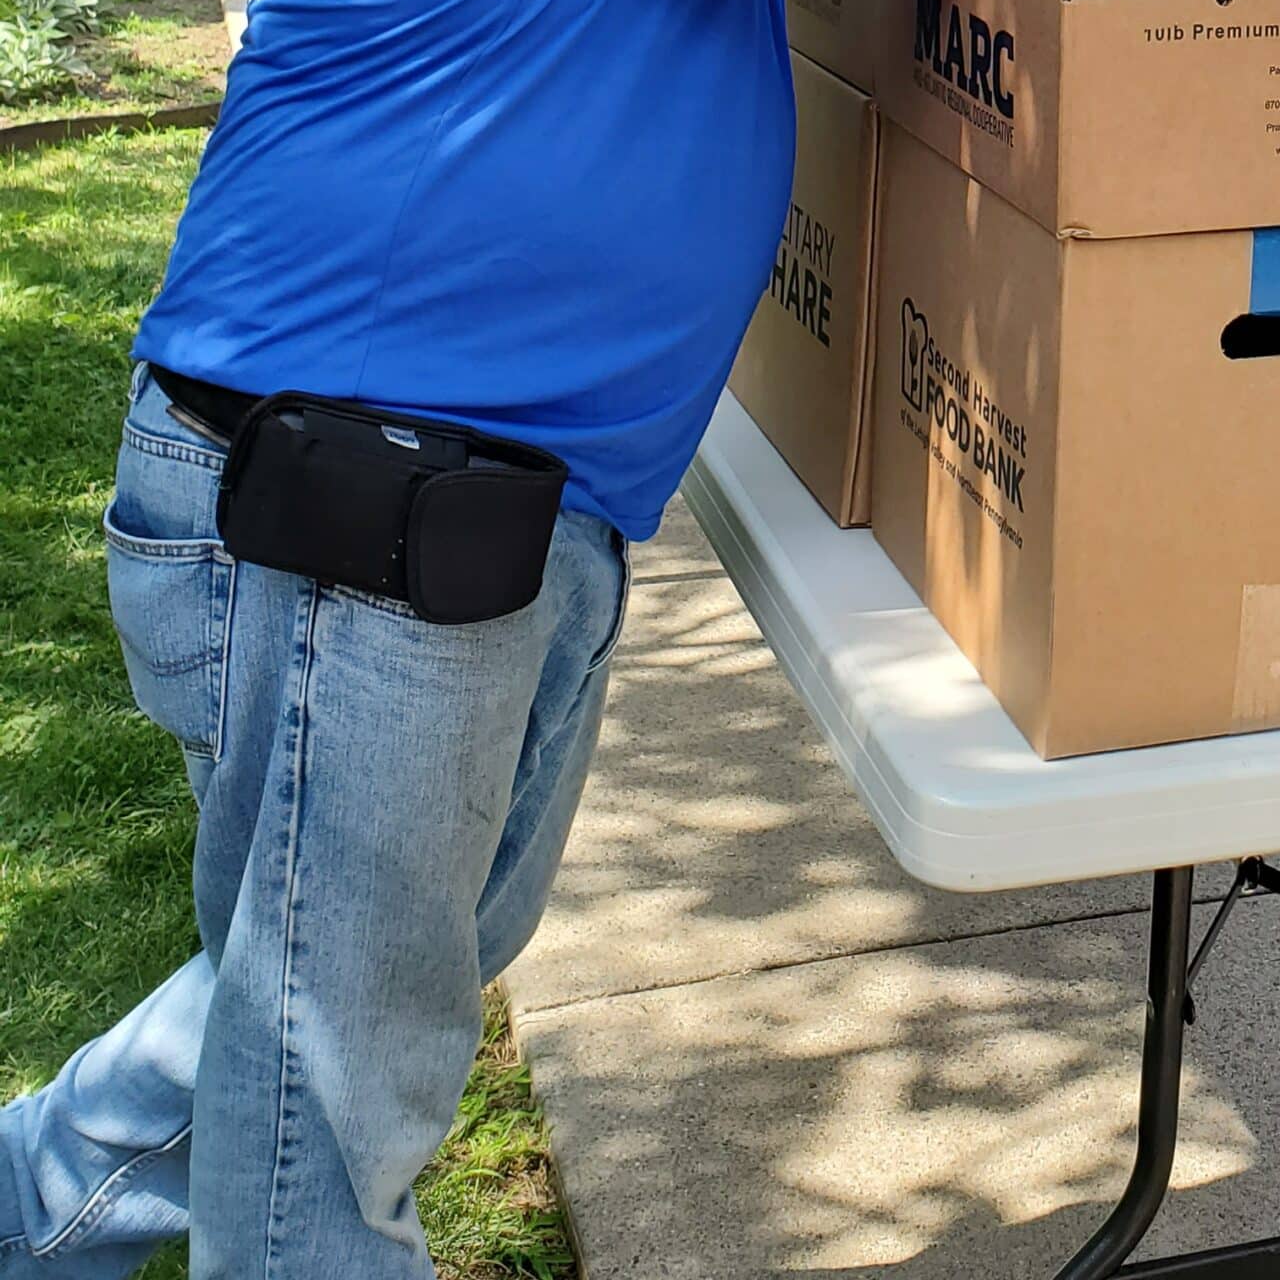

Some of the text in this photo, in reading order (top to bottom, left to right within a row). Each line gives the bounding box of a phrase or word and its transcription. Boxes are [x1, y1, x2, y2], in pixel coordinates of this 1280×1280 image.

[1193, 22, 1280, 40] Premium
[782, 200, 835, 277] ITARY
[771, 247, 832, 349] HARE
[926, 374, 1024, 513] FOOD BANK
[928, 337, 1027, 458] Second Harvest
